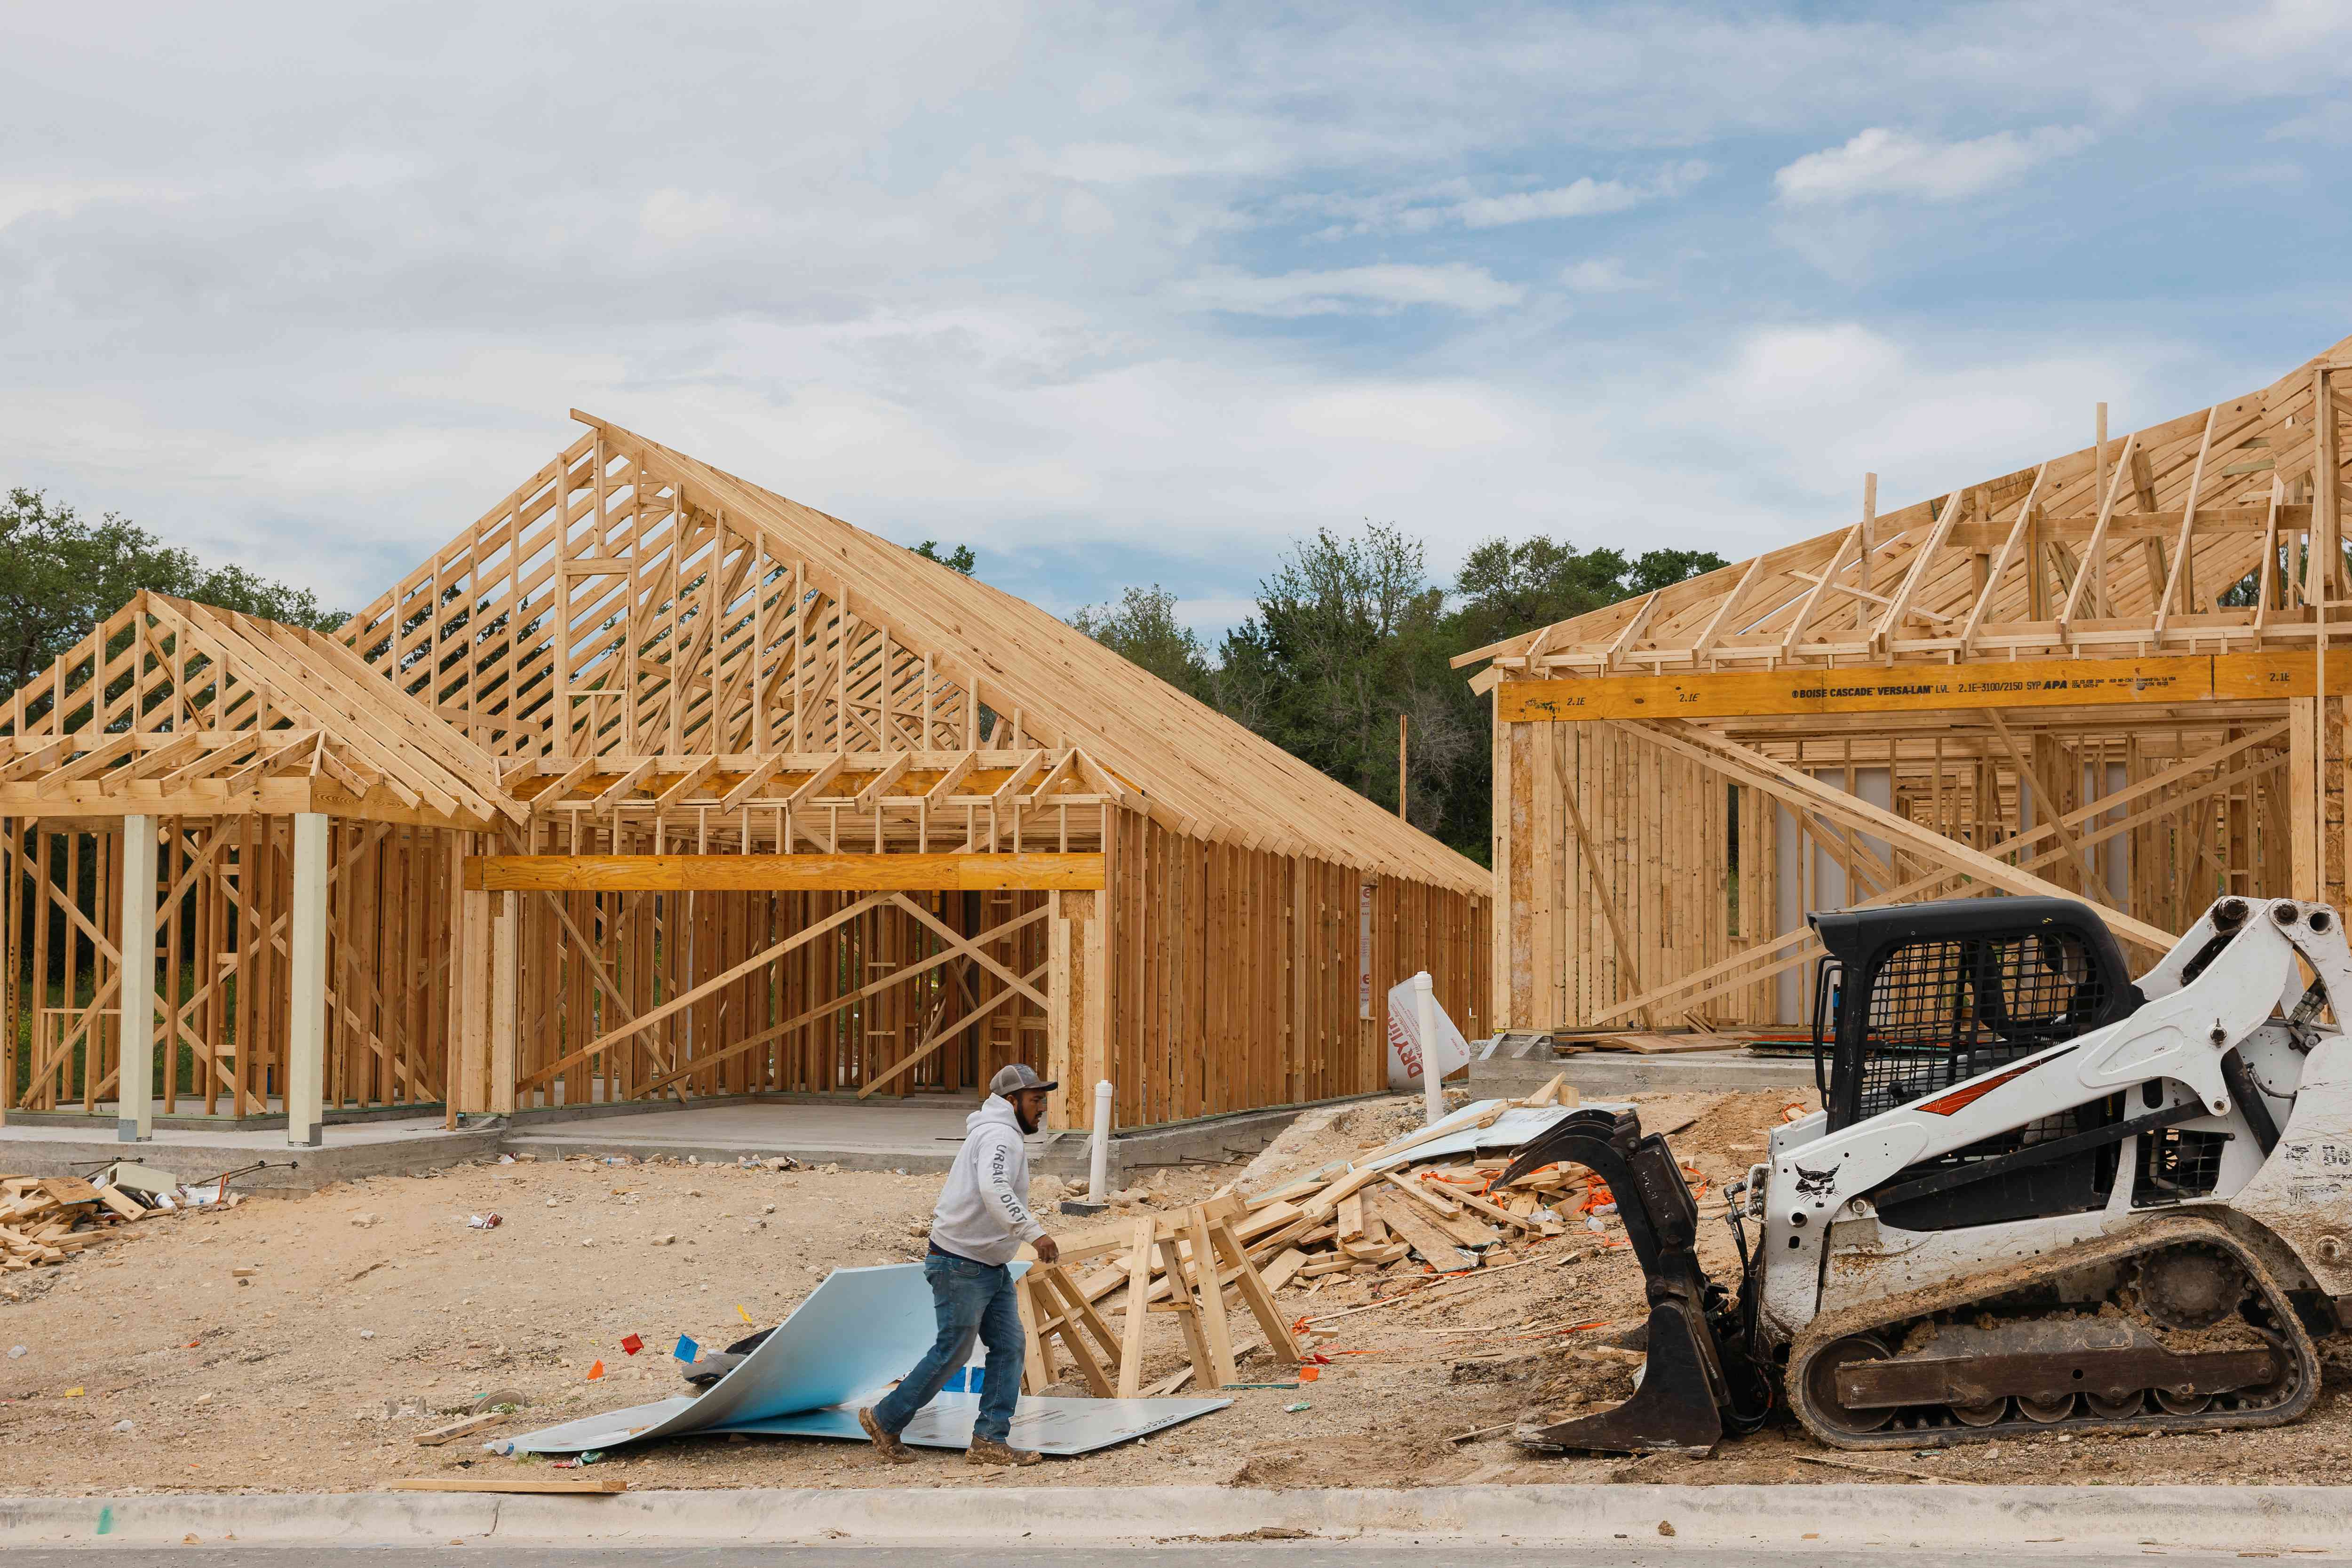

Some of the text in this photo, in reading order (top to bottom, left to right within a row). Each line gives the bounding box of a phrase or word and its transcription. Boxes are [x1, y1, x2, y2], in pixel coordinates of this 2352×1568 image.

[2269, 673, 2290, 682] 2.1E
[1800, 680, 2067, 699] BOISE CASCADE VERSA-LAM LVL 2.1E-3100/2150 SYP APA
[1566, 697, 1587, 706] 2.1E
[1679, 693, 1700, 702] 2.1E
[993, 1144, 1027, 1222] URBAN DIRT
